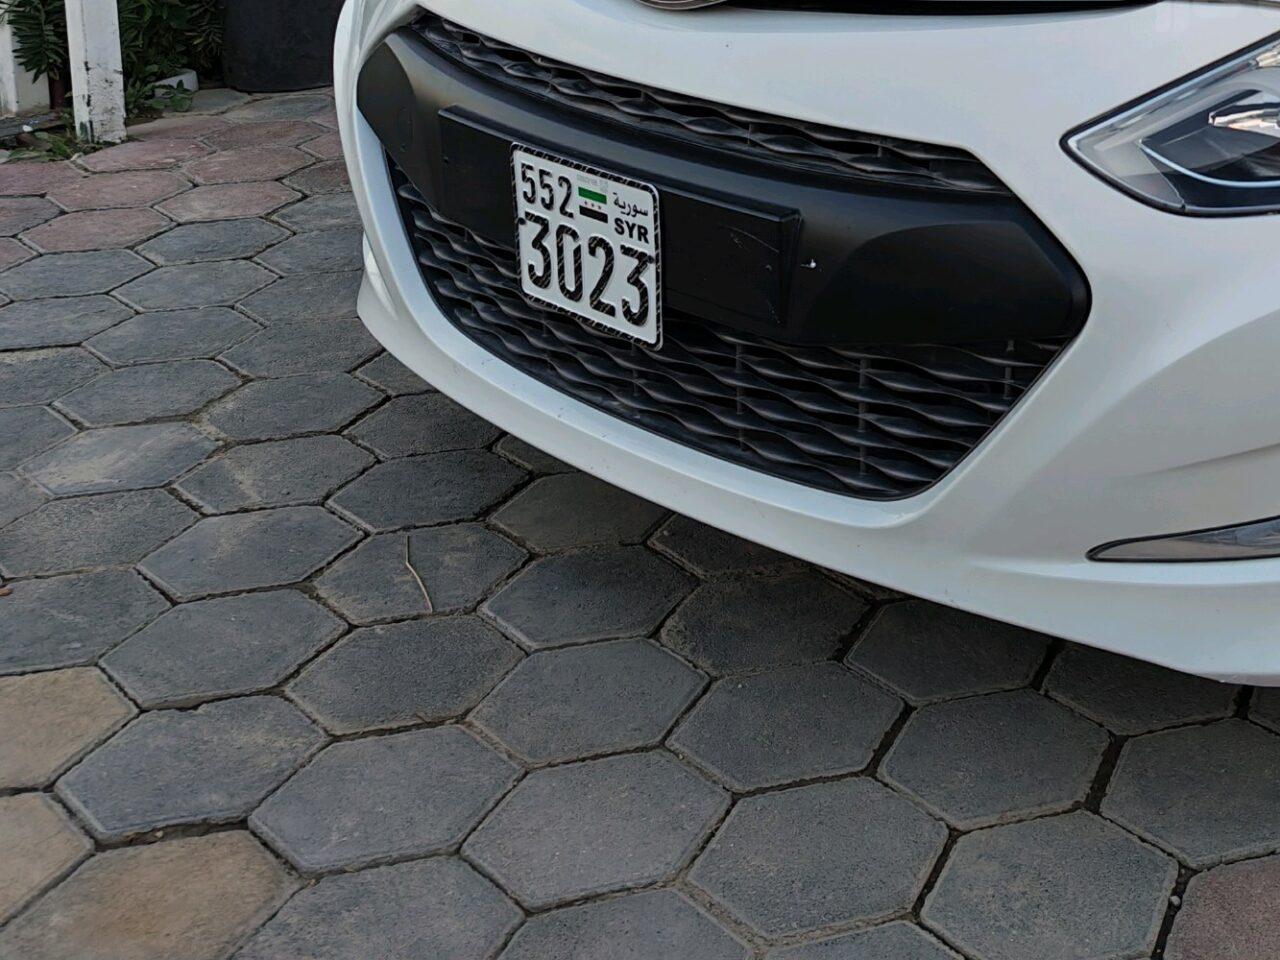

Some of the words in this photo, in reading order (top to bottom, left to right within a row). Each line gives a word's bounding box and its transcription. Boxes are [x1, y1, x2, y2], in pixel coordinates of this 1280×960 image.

[521, 162, 574, 218] 552
[613, 192, 648, 217] سورية
[615, 217, 649, 244] SYR
[525, 211, 649, 326] 3023
